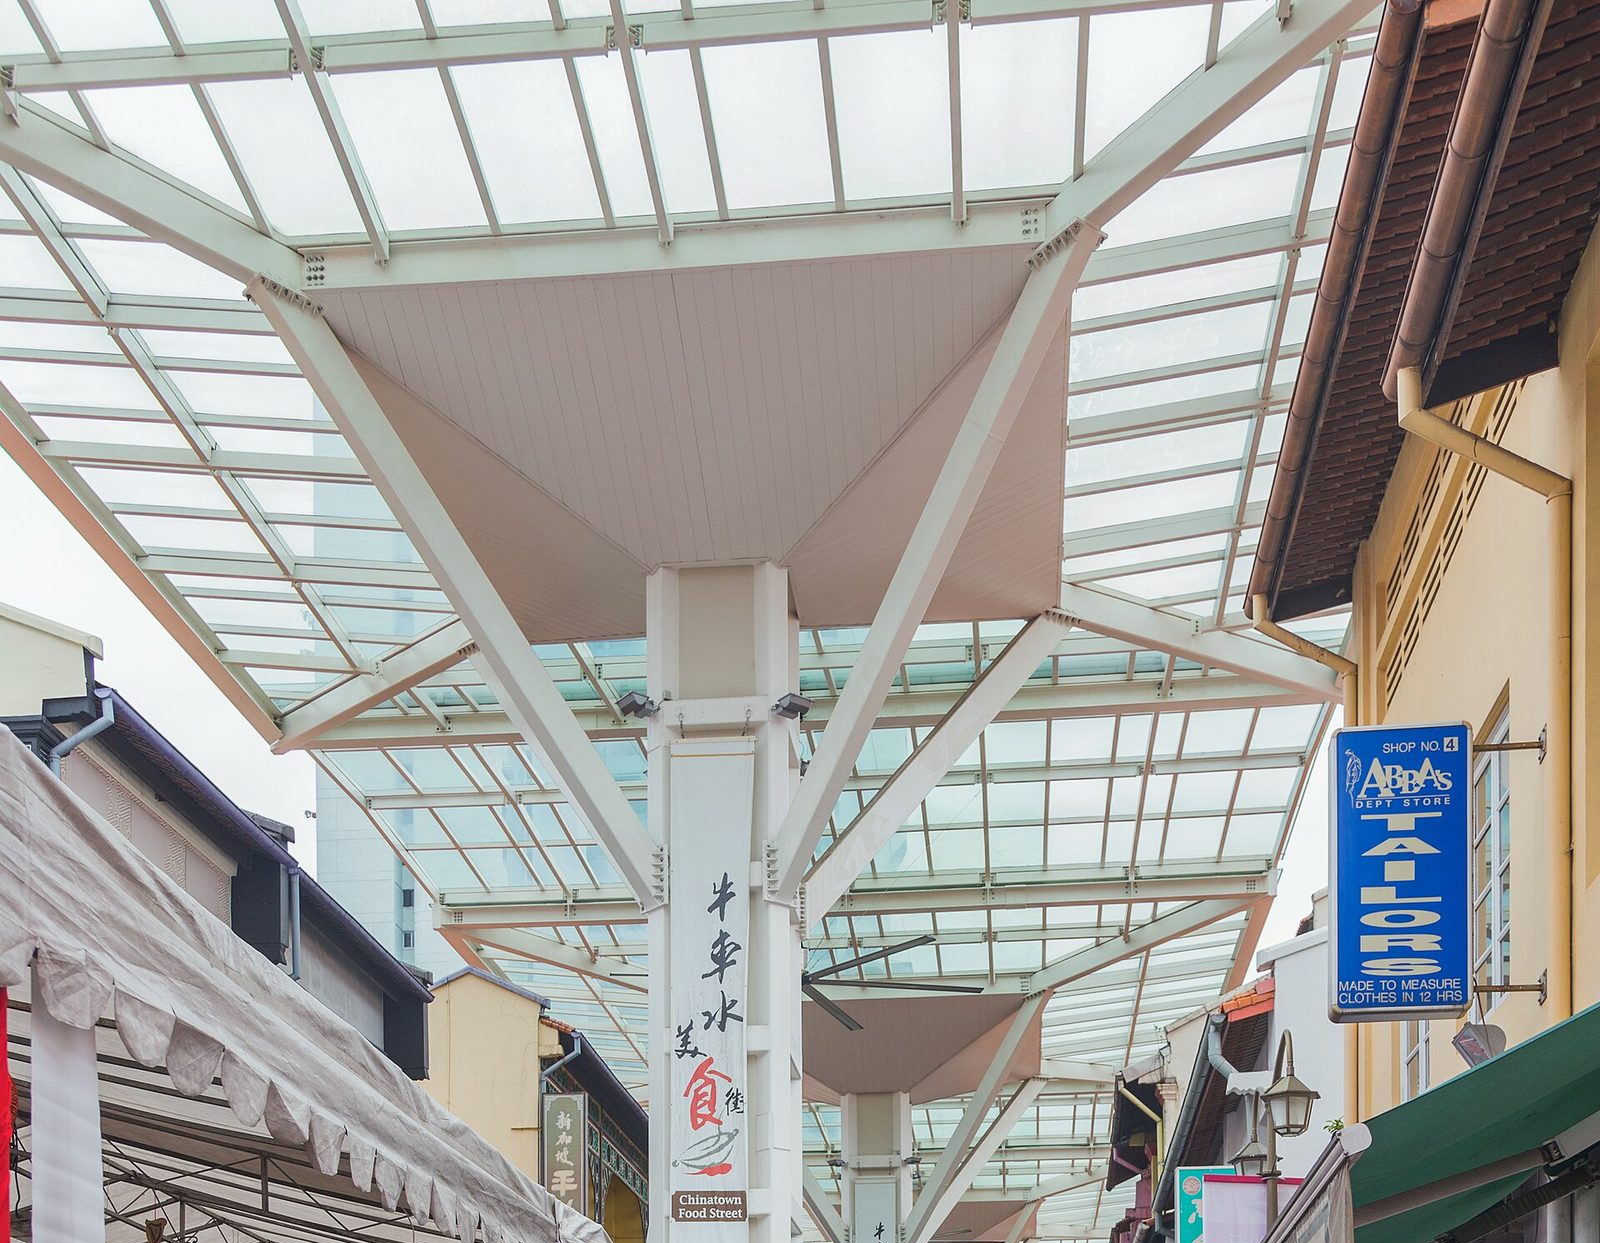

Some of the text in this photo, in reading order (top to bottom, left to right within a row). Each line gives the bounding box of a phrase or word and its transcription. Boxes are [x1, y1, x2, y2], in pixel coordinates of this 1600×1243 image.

[1382, 738, 1455, 753] SHOP NO. 4
[1357, 757, 1453, 798] ABBA'S
[1355, 797, 1451, 809] DEPT STORE
[1360, 811, 1443, 977] TAILORS
[1338, 977, 1461, 992] MADE TO MEASURE
[1338, 990, 1463, 1004] CLOTHES IN 12 HRS
[679, 1194, 742, 1205] Chinatown
[679, 1208, 743, 1219] Food Street
